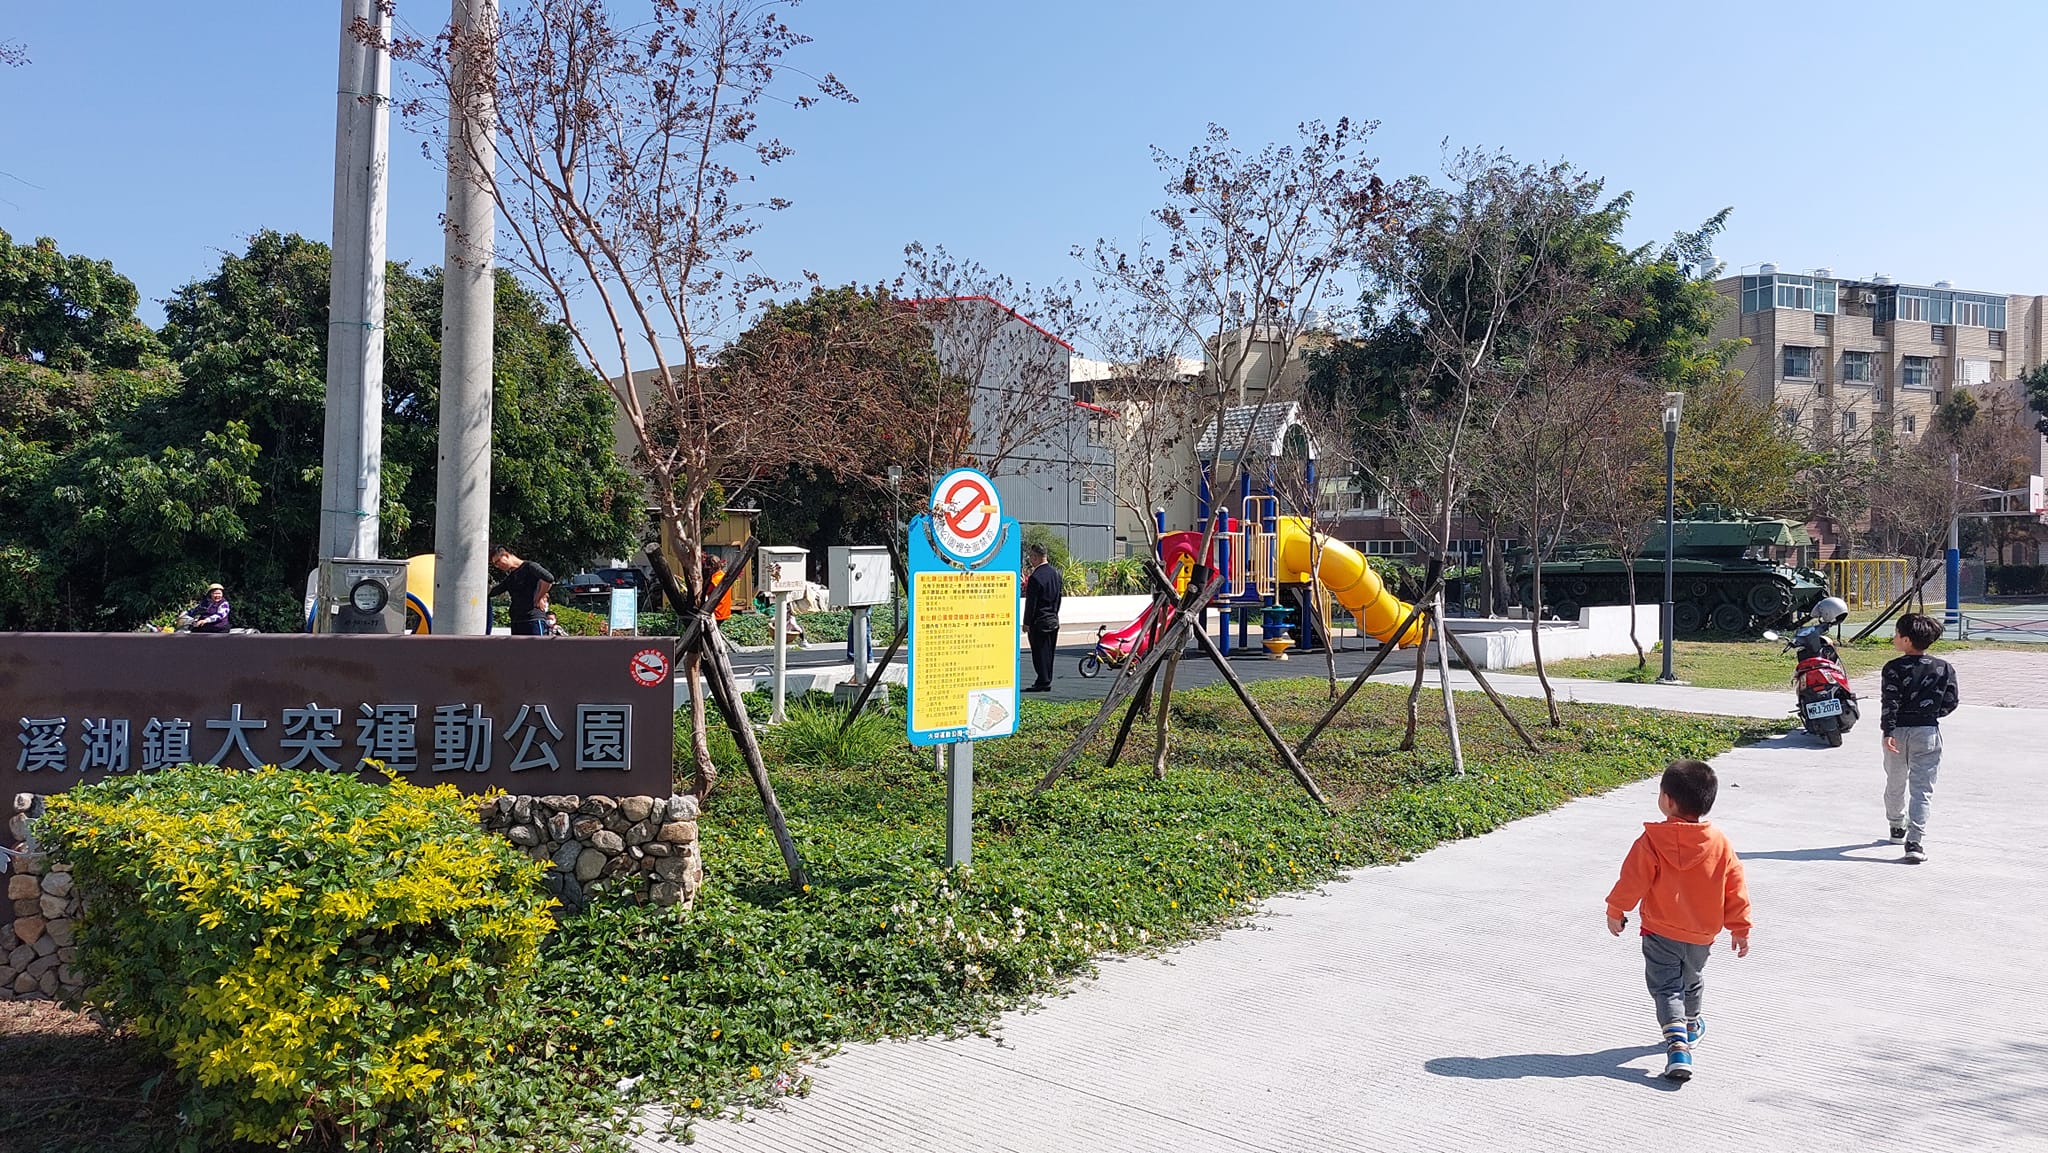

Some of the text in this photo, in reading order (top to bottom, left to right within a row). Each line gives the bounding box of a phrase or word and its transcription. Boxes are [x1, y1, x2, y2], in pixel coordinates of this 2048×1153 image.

[1808, 703, 1841, 716] MRJ-2078
[16, 702, 633, 773] 溪湖鎮大突運動公園
